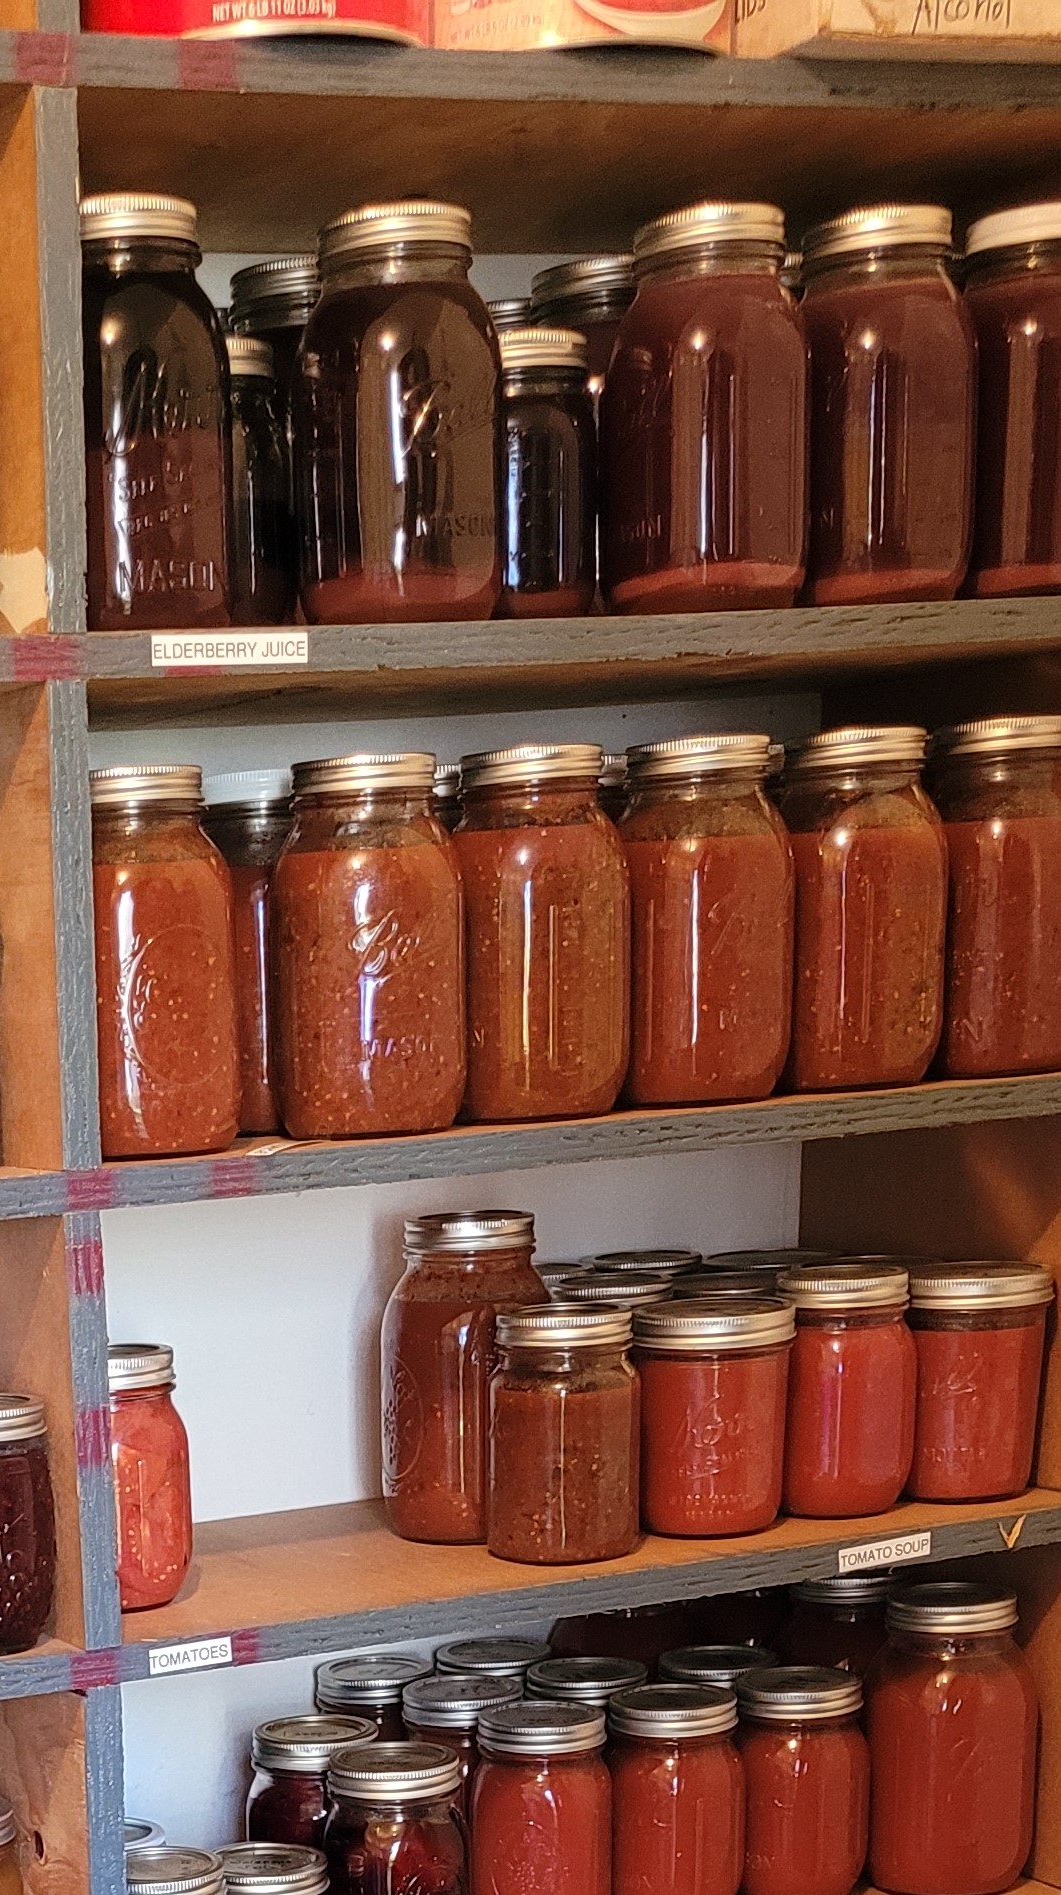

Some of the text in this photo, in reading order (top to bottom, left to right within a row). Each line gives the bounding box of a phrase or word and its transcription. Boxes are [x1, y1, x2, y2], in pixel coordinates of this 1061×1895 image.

[212, 2, 230, 23] NET
[231, 0, 247, 20] WT
[256, 0, 269, 17] LB
[270, 0, 282, 16] 11
[283, 0, 296, 15] OZ
[911, 0, 1011, 34] Alcohol
[153, 640, 306, 660] ELDERBERRY JUICE
[840, 1538, 929, 1568] TOMATO SOUP
[149, 1643, 229, 1669] TOMATOES
